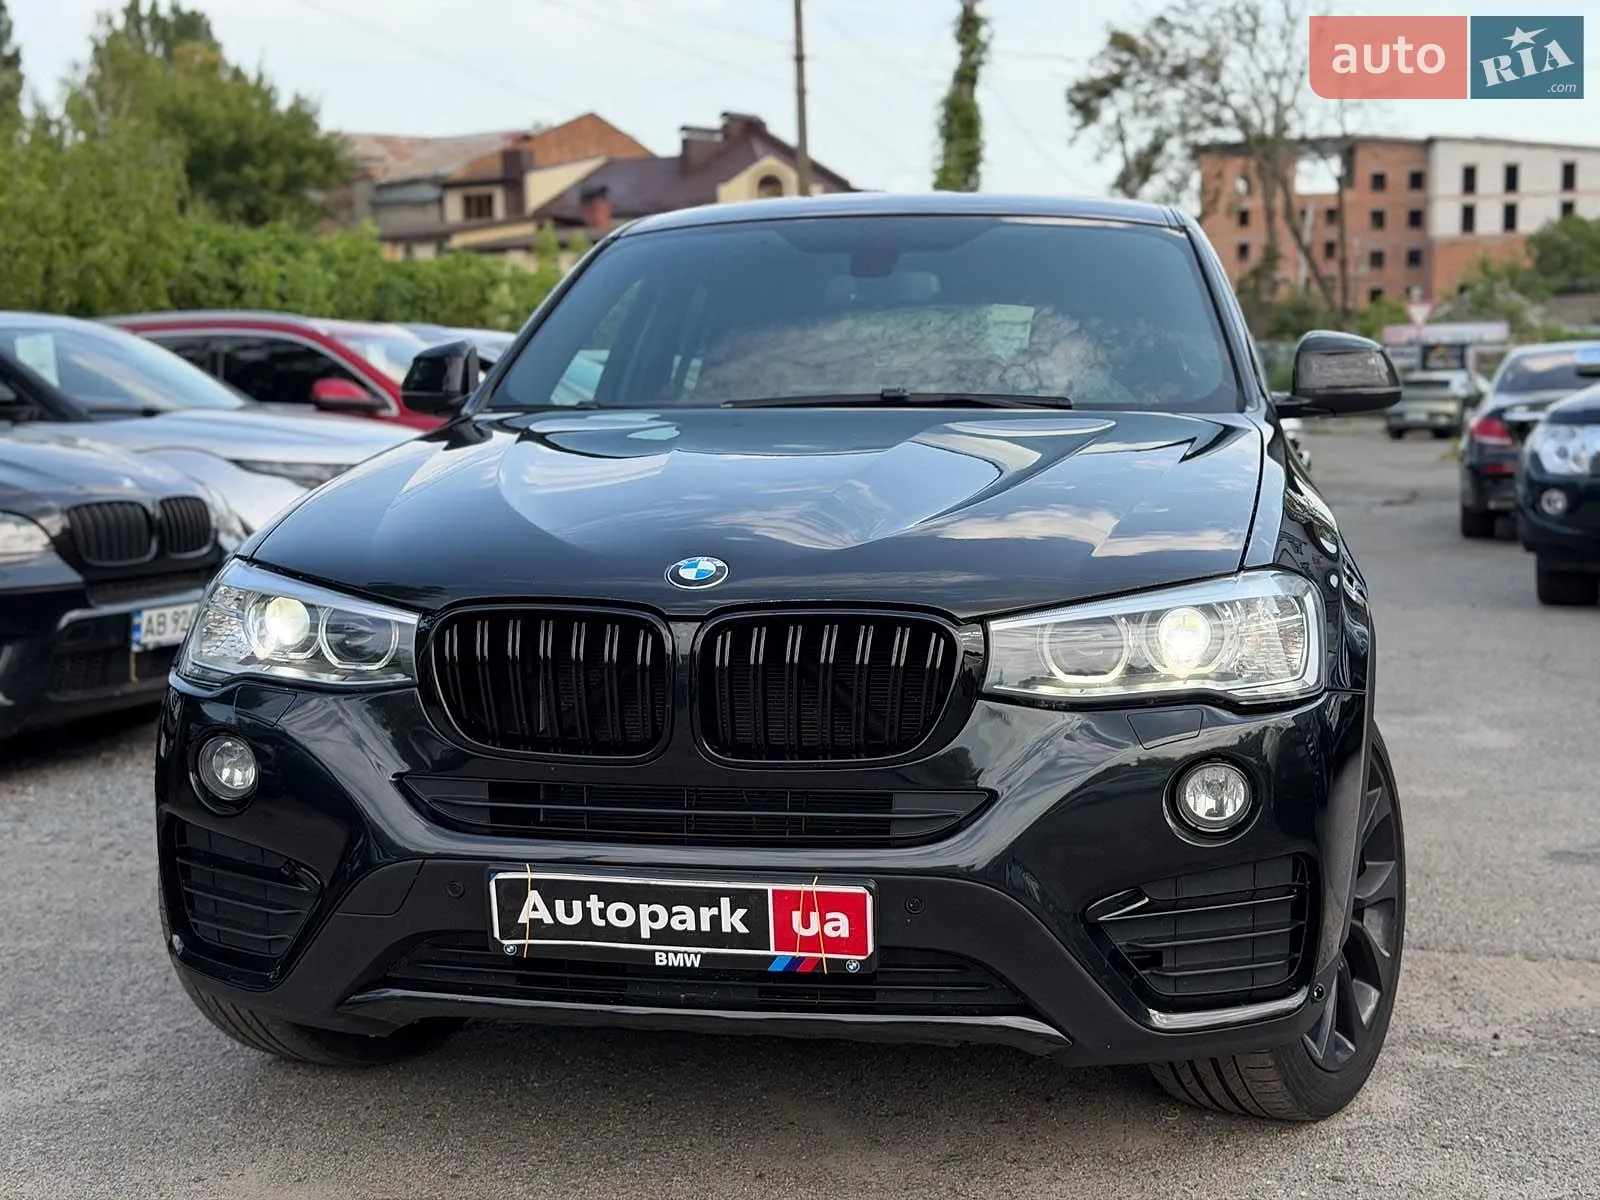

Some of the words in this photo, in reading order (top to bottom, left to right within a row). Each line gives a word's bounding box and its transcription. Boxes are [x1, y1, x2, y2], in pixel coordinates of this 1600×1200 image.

[144, 612, 167, 637] AB
[517, 889, 750, 939] Autopark
[791, 910, 850, 938] ua
[654, 951, 702, 968] BMW
